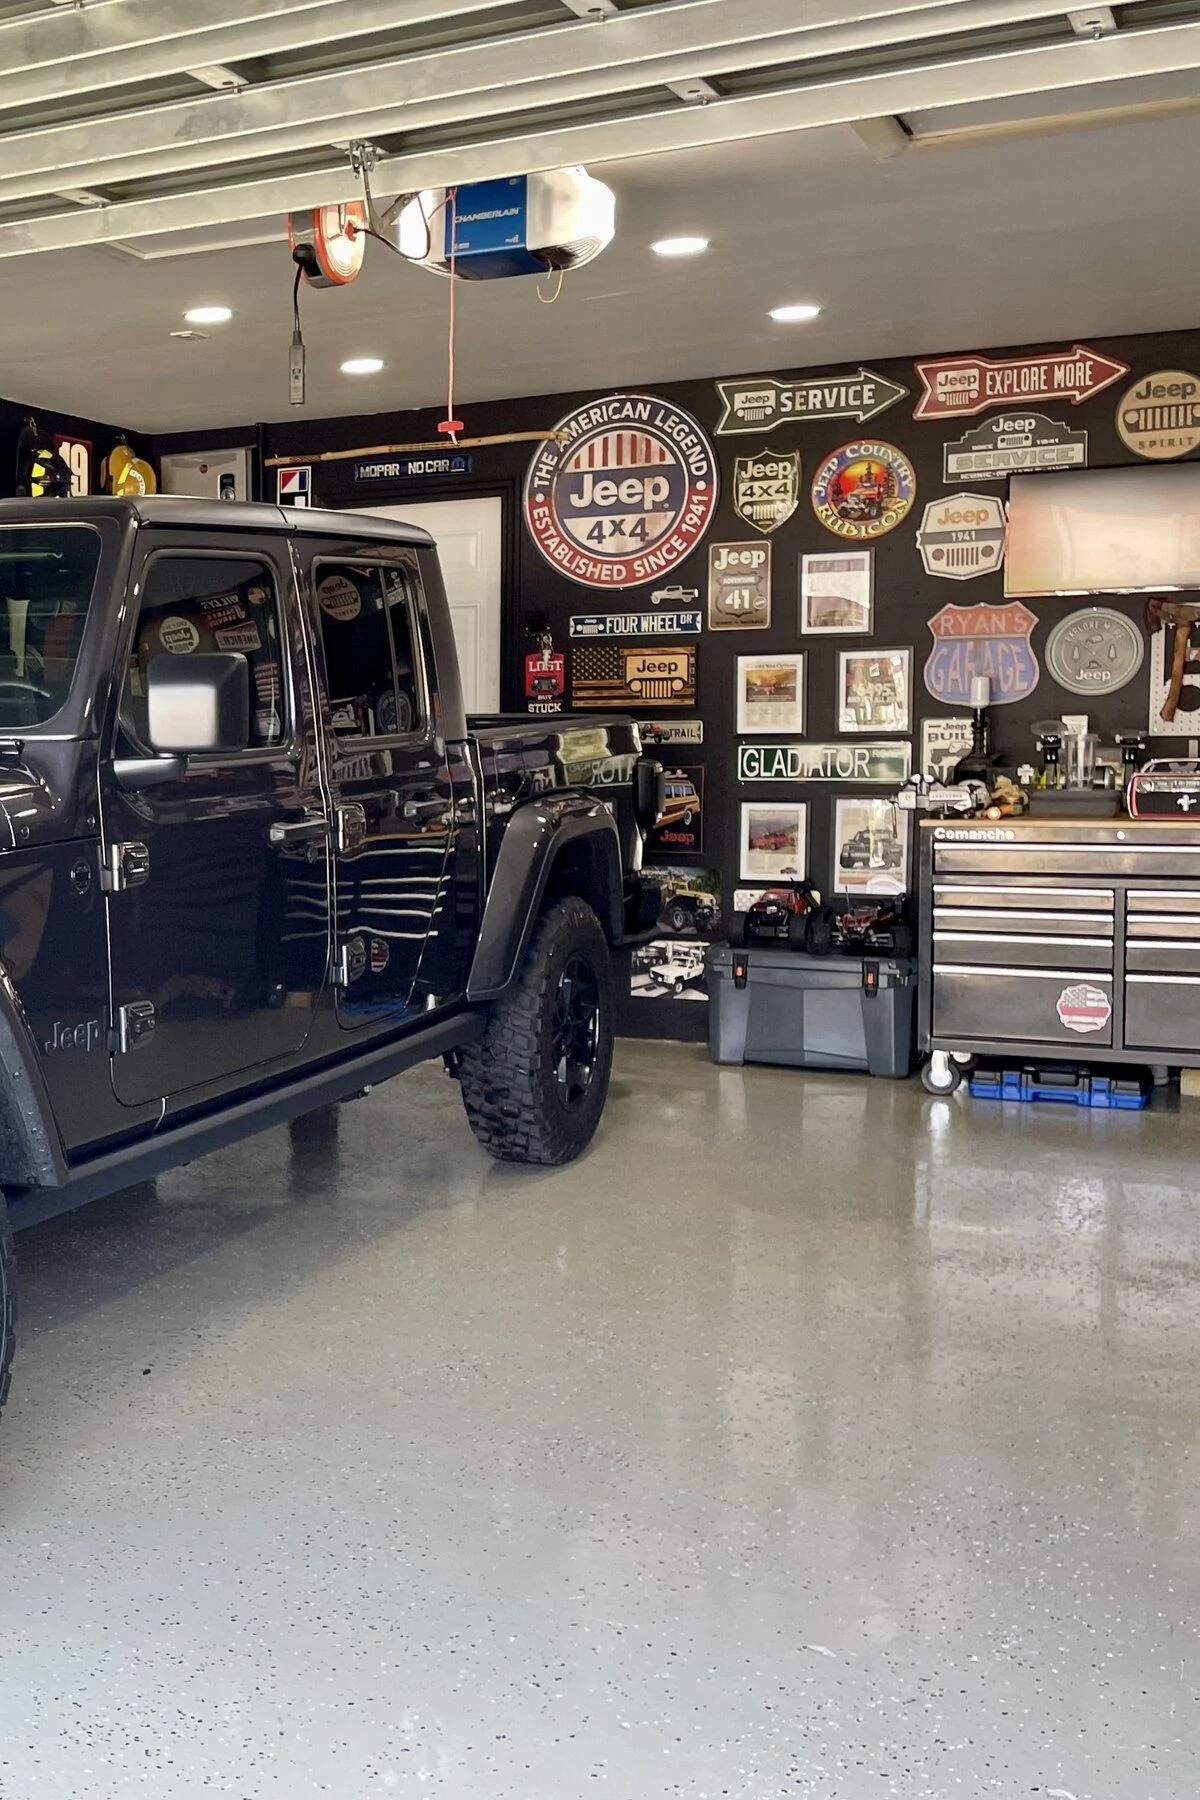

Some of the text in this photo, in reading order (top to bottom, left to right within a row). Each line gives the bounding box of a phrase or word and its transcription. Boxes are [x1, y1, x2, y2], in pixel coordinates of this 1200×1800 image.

[455, 207, 519, 224] CHAMBERLAIN
[939, 373, 977, 388] Jeep
[986, 360, 1093, 395] EXPLORE MORE
[741, 393, 770, 405] Jeep
[780, 383, 876, 413] SERVICE
[1135, 381, 1196, 399] Jeep
[992, 417, 1036, 432] Jeep
[533, 402, 708, 488] THE AMERICAN LEGEND
[1138, 436, 1194, 450] SPIRIT
[408, 460, 424, 474] NO
[425, 459, 449, 473] CAR
[955, 446, 1075, 470] SERVICE
[59, 441, 88, 497] 19
[360, 463, 400, 479] MOPAR
[741, 460, 792, 479] Jeep
[813, 444, 913, 497] JEEP COUNTRY
[569, 473, 670, 510] Jeep
[818, 498, 909, 539] RUBICON
[937, 508, 989, 526] Jeep
[533, 494, 709, 581] ESTABLISHED SINCE 1941
[951, 530, 977, 542] 1941
[714, 548, 766, 570] Jeep
[725, 589, 750, 609] 41
[606, 614, 692, 634] FOUR WHEEL DR
[940, 612, 1029, 636] RYAN'S
[528, 660, 563, 672] LOST
[636, 659, 678, 674] Jeep
[930, 640, 1029, 694] GARAGE
[1075, 669, 1111, 681] Jeep
[528, 703, 562, 713] STUCK
[669, 728, 696, 738] TRAIL
[943, 723, 968, 731] Jeep
[928, 732, 973, 743] BUIL
[743, 749, 870, 778] GLADIATOR
[660, 830, 695, 845] Jeep
[933, 827, 1015, 840] Comanche
[45, 1019, 99, 1056] Jeep
